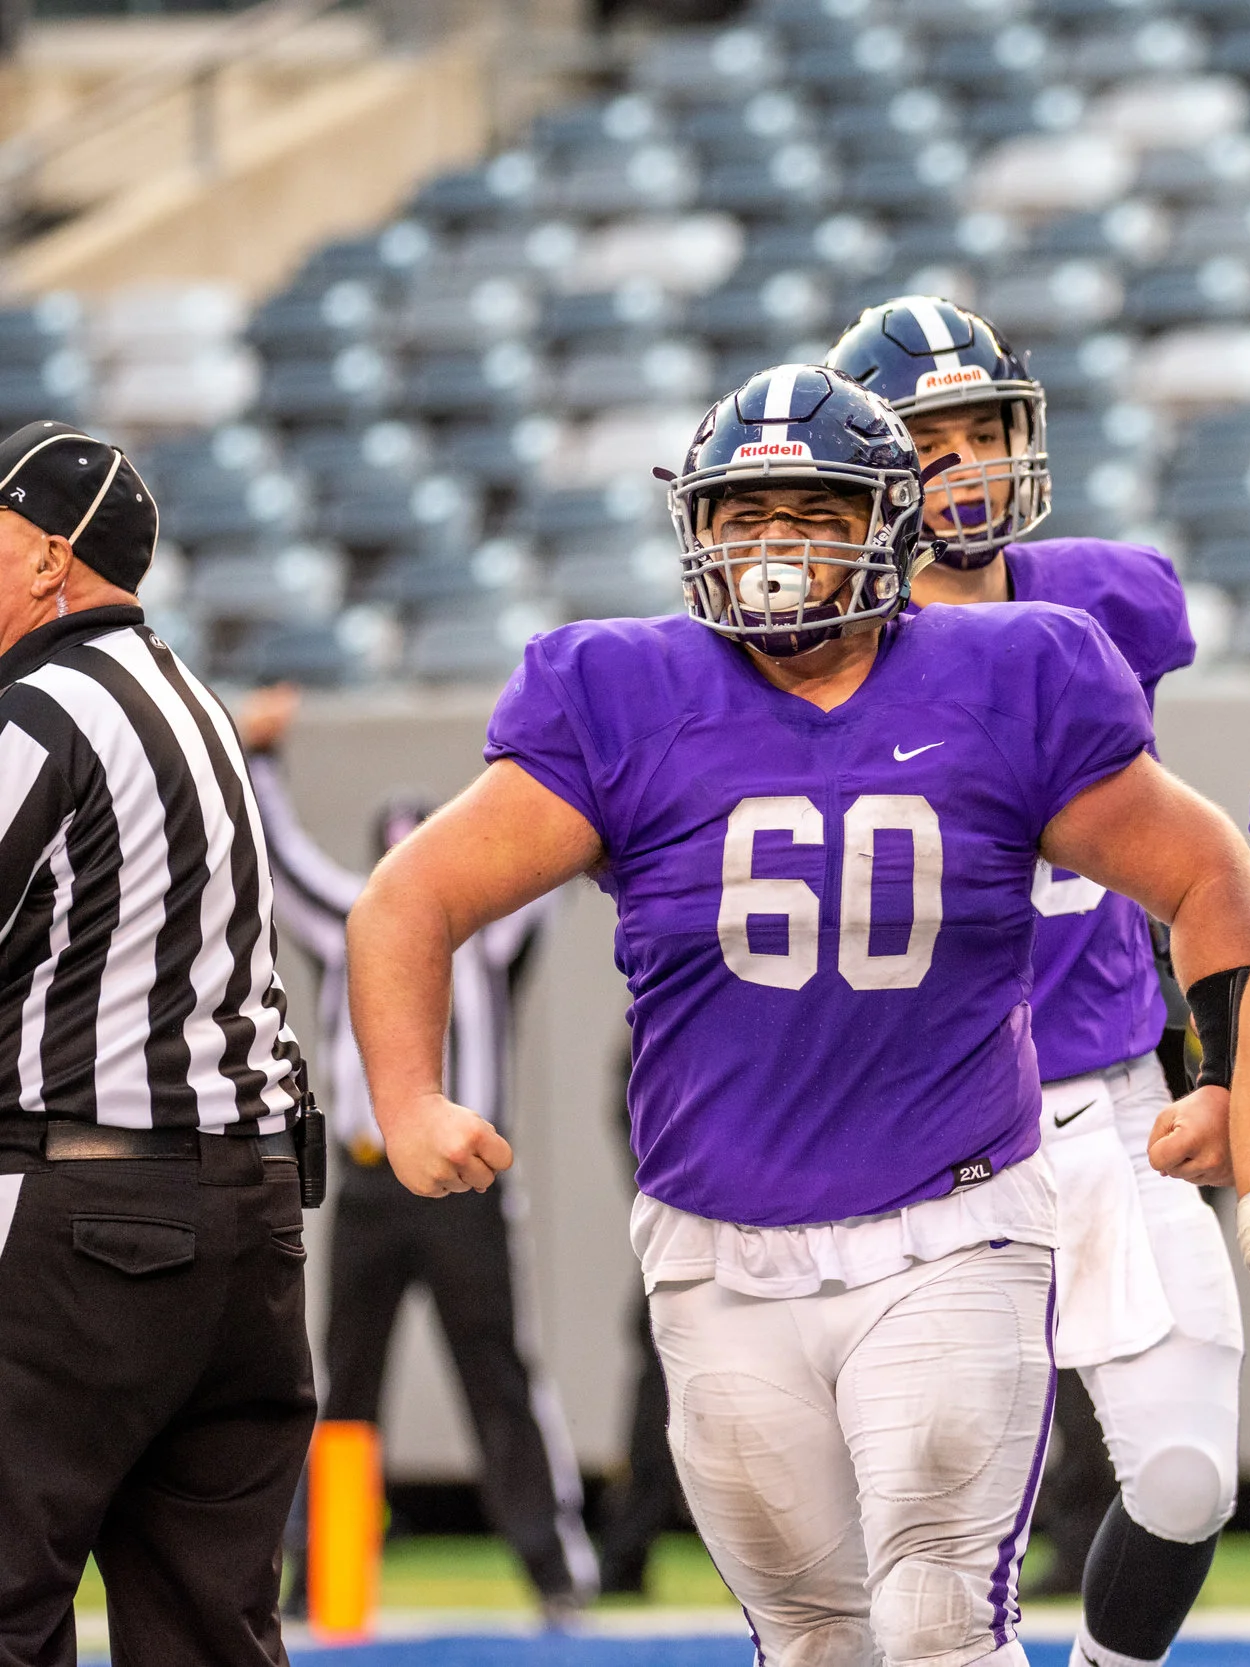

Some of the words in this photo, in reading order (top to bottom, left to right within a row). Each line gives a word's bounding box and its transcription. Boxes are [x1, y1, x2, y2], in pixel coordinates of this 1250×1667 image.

[926, 370, 981, 388] Riddell
[741, 444, 803, 458] Riddell
[718, 795, 943, 990] 60
[960, 1164, 990, 1182] 2XL
